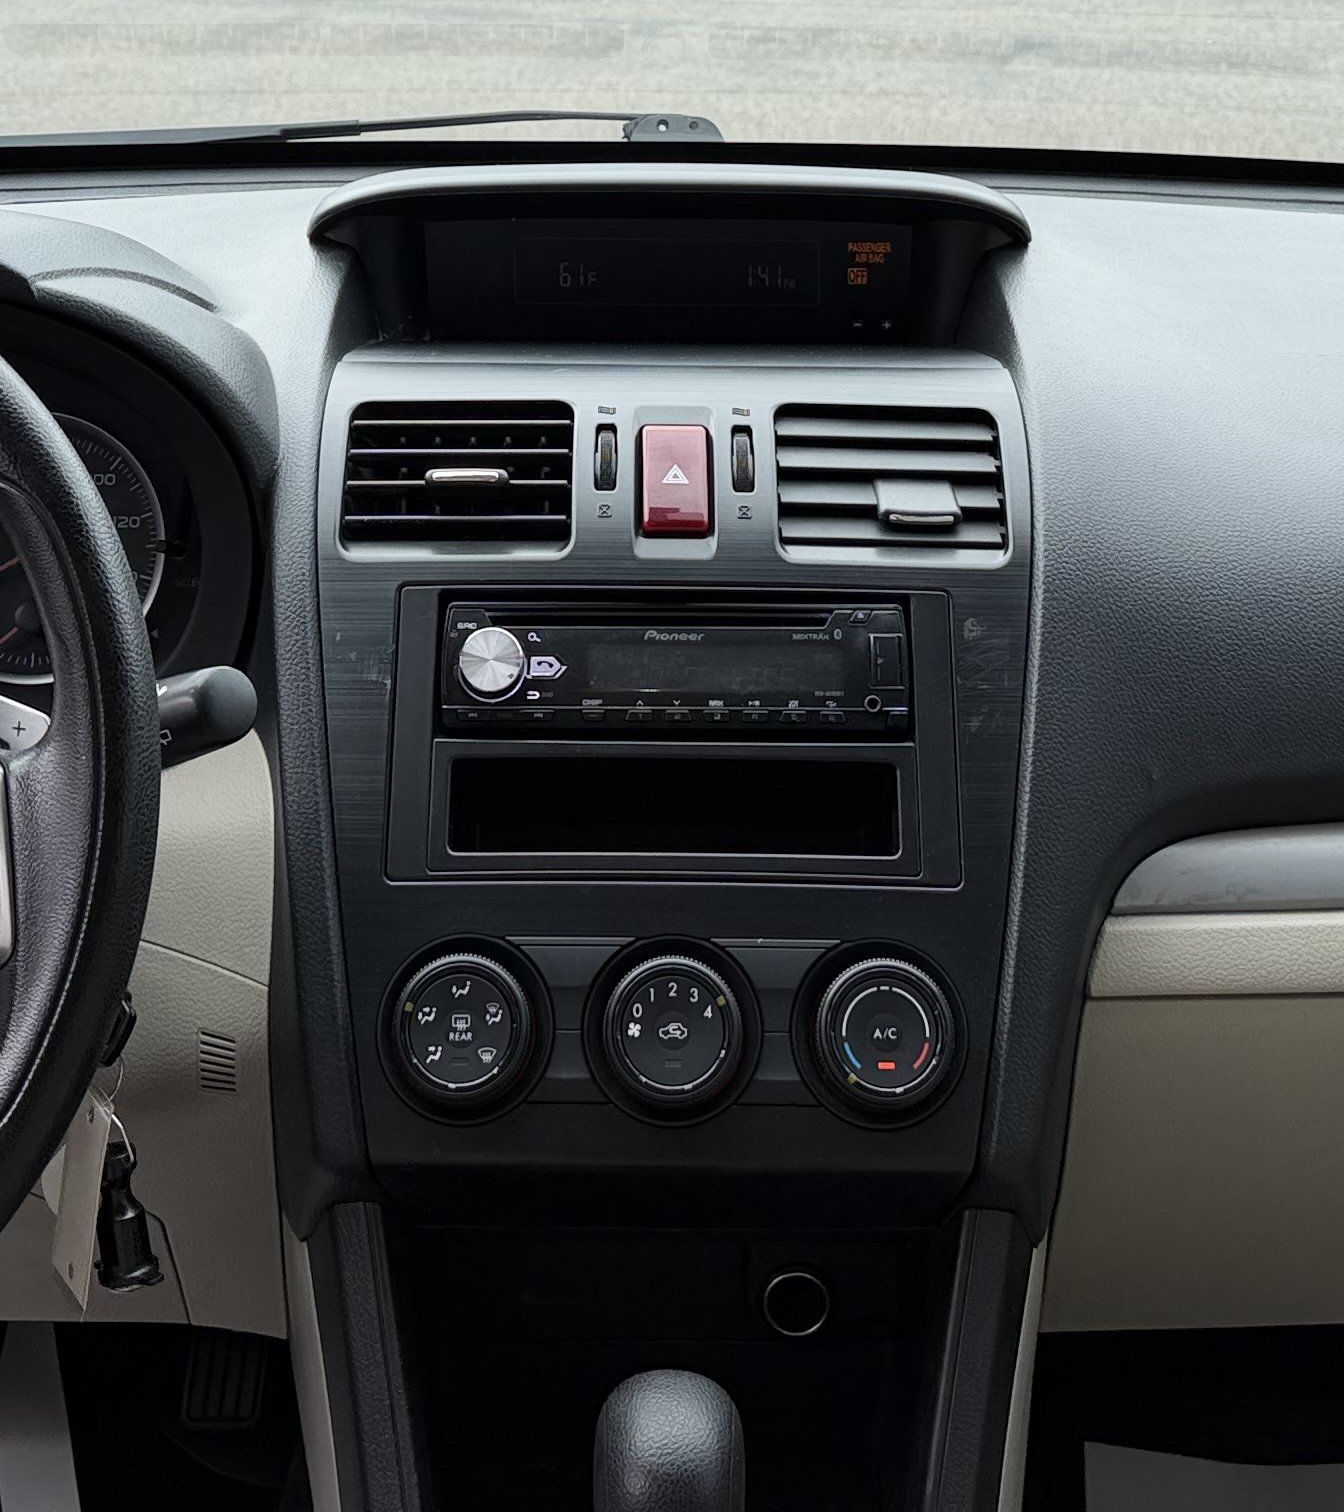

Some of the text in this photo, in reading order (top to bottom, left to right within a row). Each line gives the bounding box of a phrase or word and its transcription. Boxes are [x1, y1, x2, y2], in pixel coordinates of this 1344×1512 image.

[94, 474, 116, 486] 00
[644, 630, 705, 642] Pioneer
[650, 987, 655, 1003] 1
[668, 982, 678, 997] 2
[690, 987, 699, 1003] 3
[632, 1003, 643, 1018] 0
[703, 1004, 713, 1019] 4
[448, 1031, 473, 1042] REAR
[873, 1027, 898, 1040] A/C
